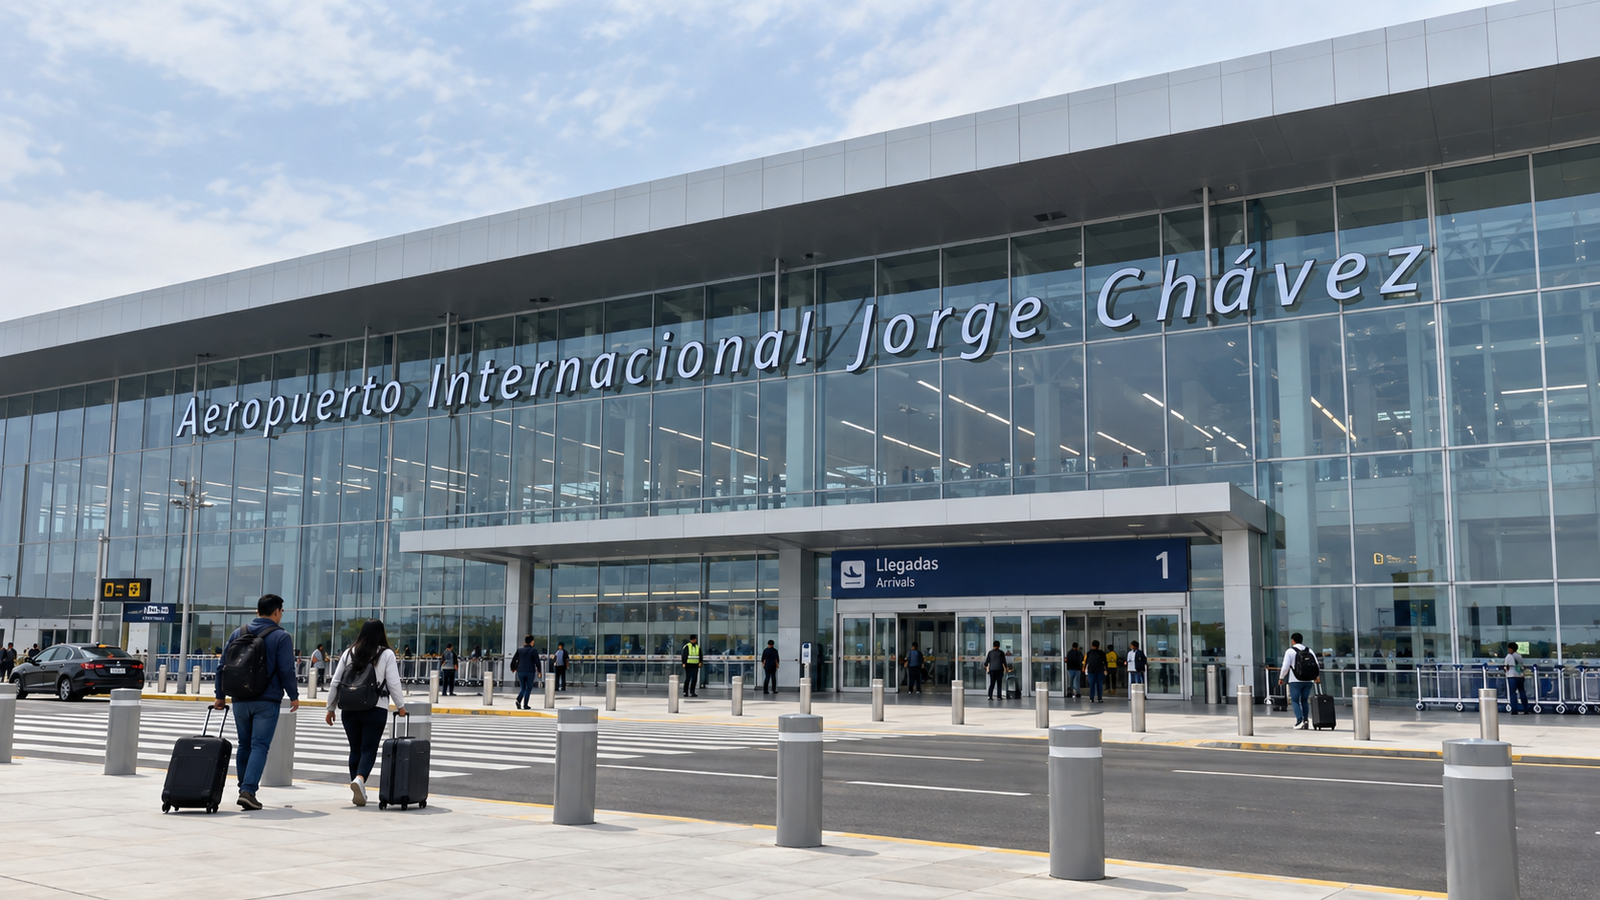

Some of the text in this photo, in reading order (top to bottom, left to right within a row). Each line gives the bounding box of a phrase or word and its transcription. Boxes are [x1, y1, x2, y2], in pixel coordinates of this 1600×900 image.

[176, 244, 1425, 438] Aeropuerto Internacional Jorge Chávez
[876, 557, 939, 575] Llegadas
[1155, 551, 1169, 579] 1
[876, 577, 915, 588] Arrivals
